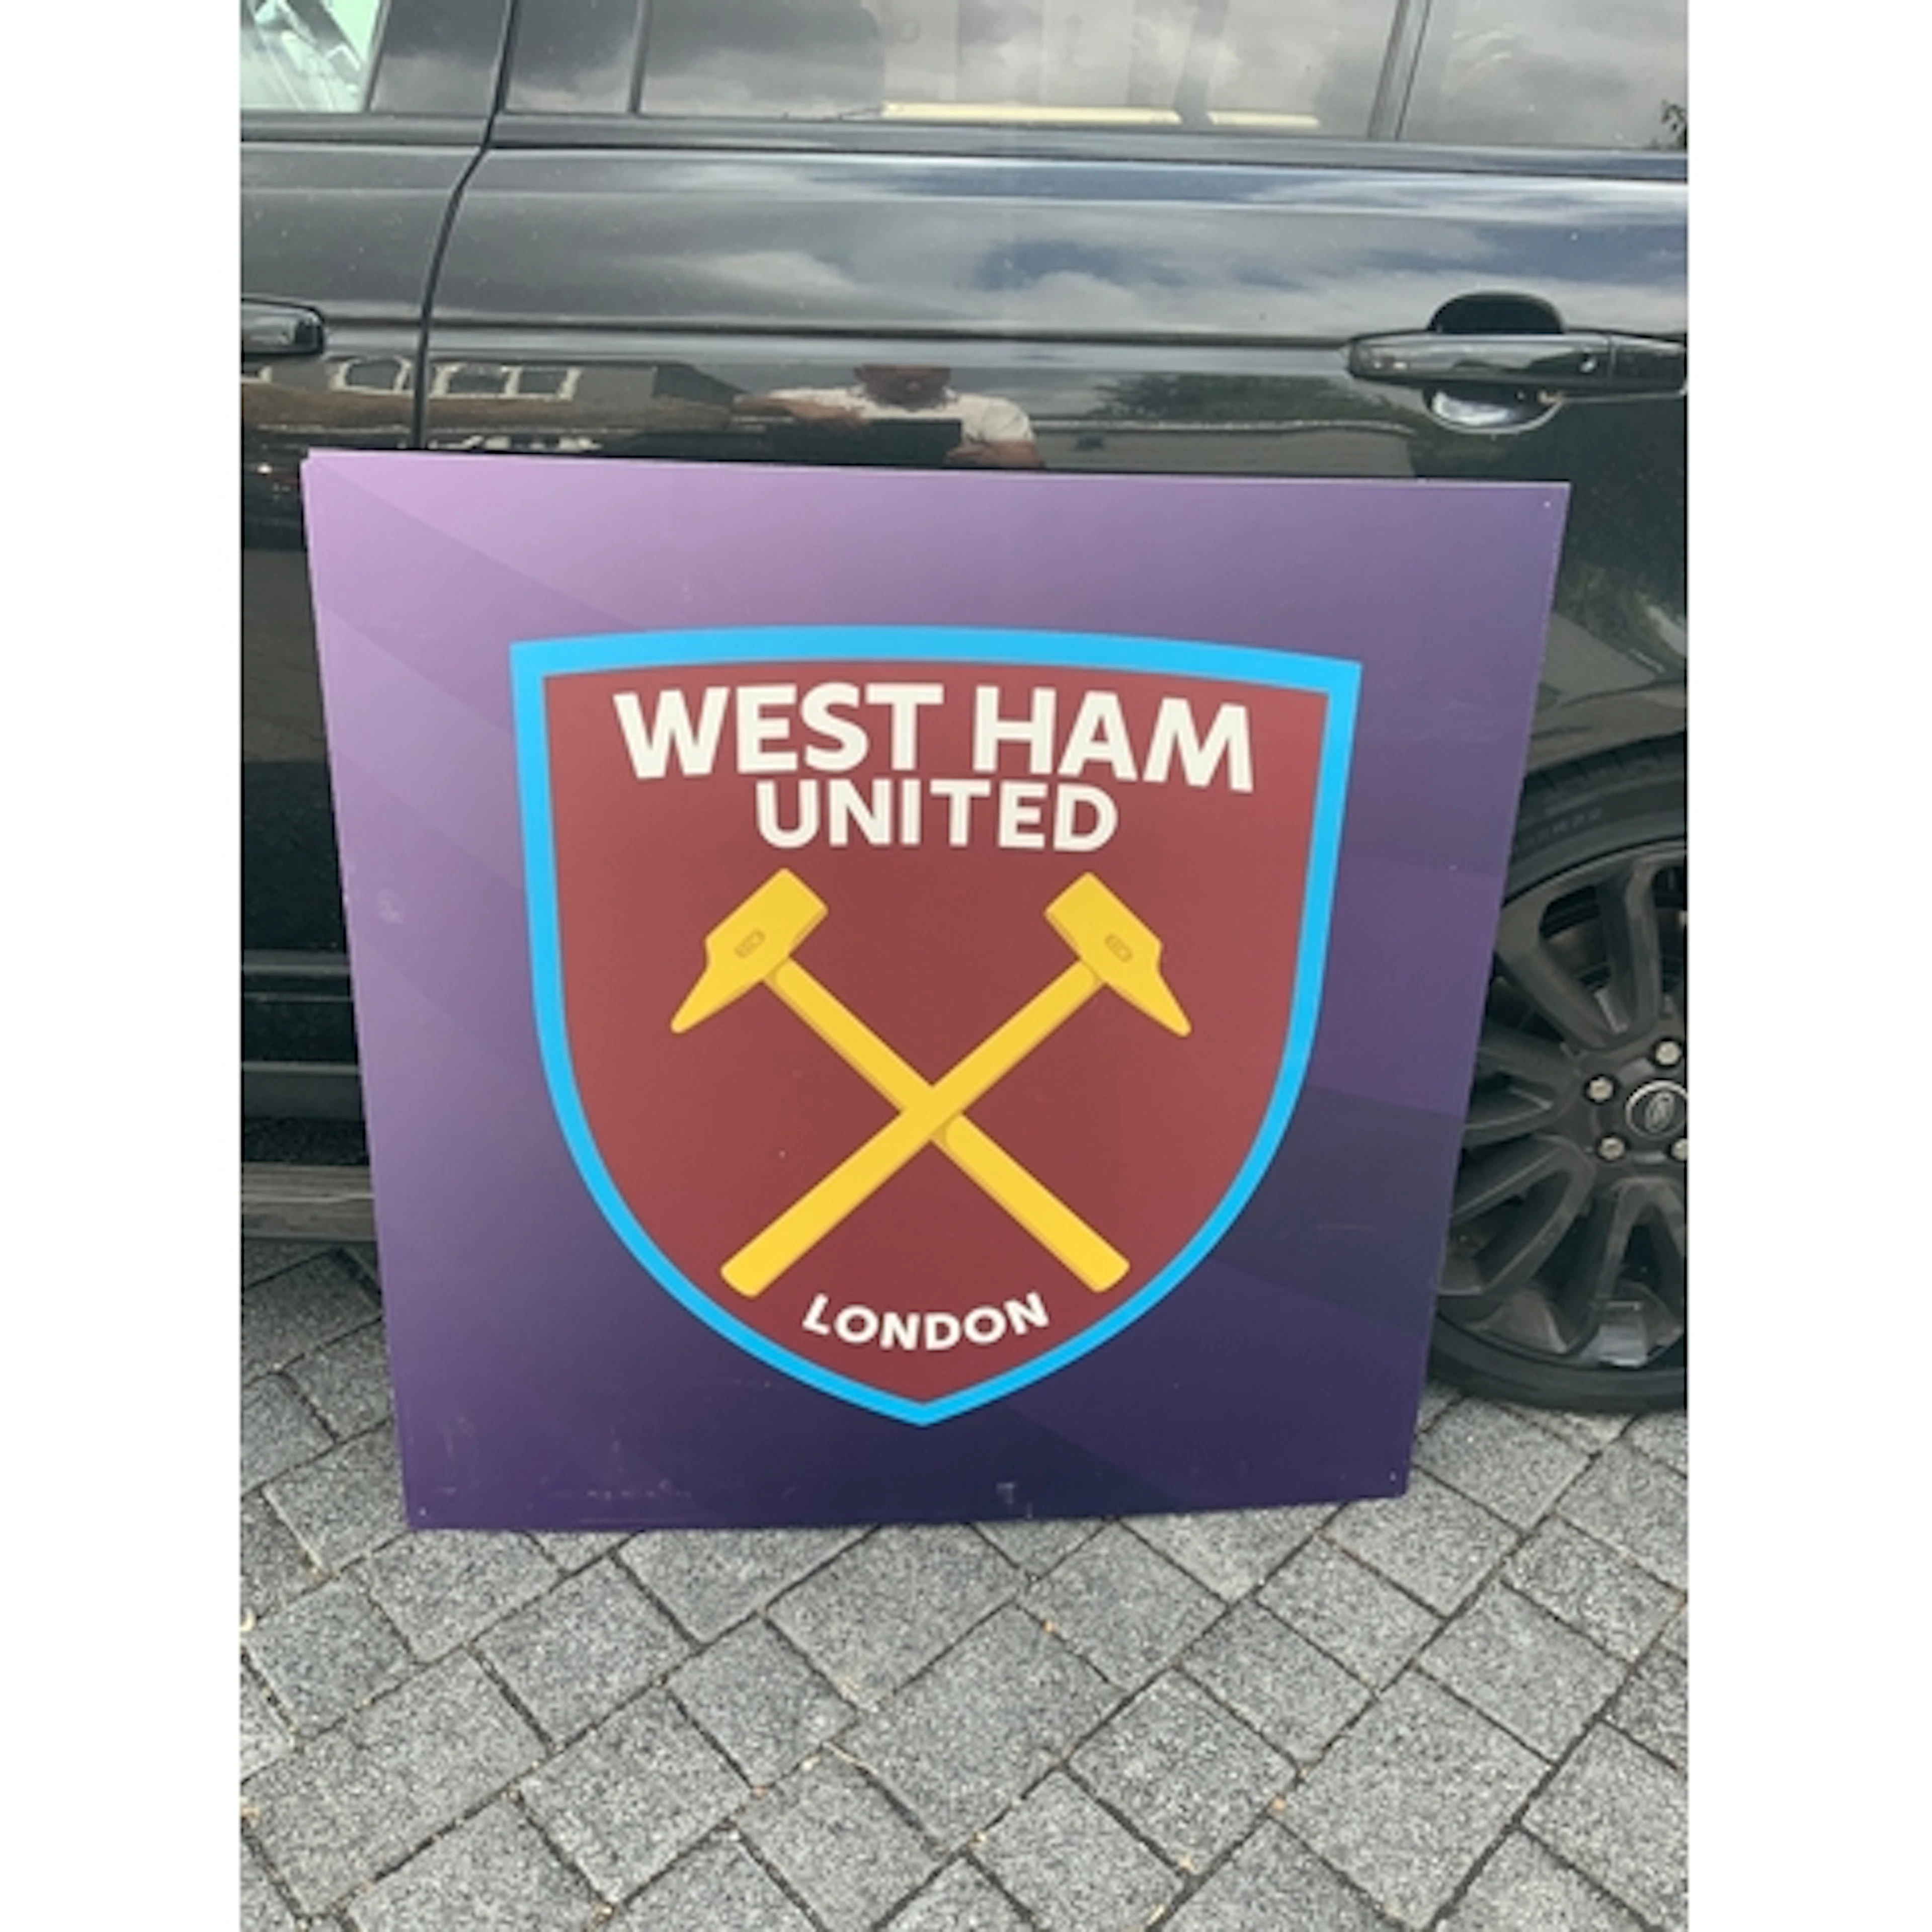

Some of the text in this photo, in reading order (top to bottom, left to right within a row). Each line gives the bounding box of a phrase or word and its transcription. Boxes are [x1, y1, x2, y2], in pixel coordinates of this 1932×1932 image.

[613, 682, 1253, 792] WEST HAM
[756, 779, 1117, 852] UNITED
[802, 1292, 1049, 1350] LONDON
